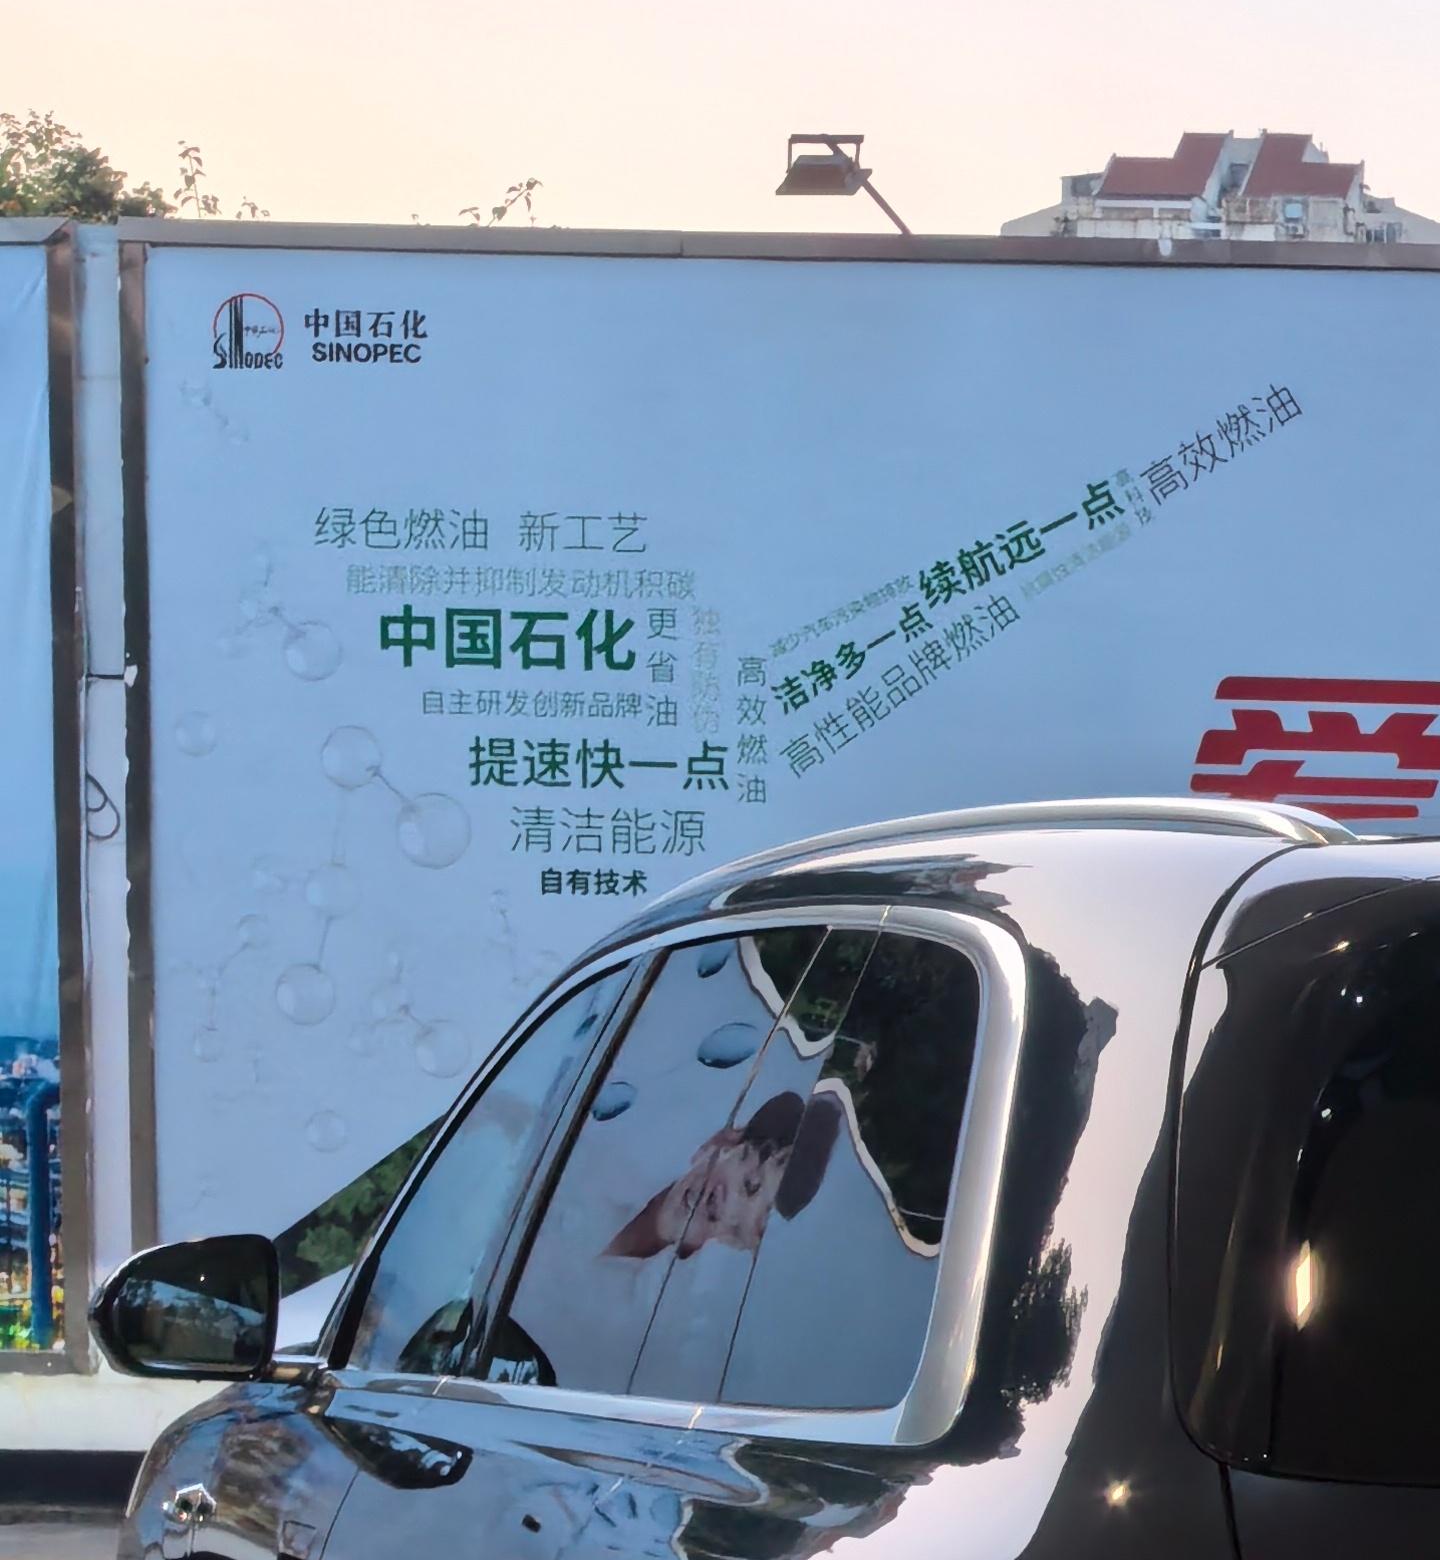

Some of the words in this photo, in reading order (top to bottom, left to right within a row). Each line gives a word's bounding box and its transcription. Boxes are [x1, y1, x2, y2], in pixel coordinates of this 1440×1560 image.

[304, 307, 428, 340] 中国石化
[311, 342, 422, 364] SINOPEC
[1139, 384, 1303, 505] 高效燃油
[314, 507, 489, 551] 绿色燃油
[519, 511, 648, 553] 新工艺
[919, 480, 1125, 608] 续航远一点
[380, 604, 636, 671] 中国石化
[646, 607, 679, 728] 更省油
[770, 602, 934, 715] 洁净多一点
[422, 690, 643, 720] 自主研发创新品牌
[779, 594, 1021, 780] 高性能品牌燃油
[737, 655, 767, 805] 高效燃油
[468, 736, 730, 791] 提速快一点
[511, 806, 706, 856] 清洁能源
[541, 867, 648, 896] 自有技术
